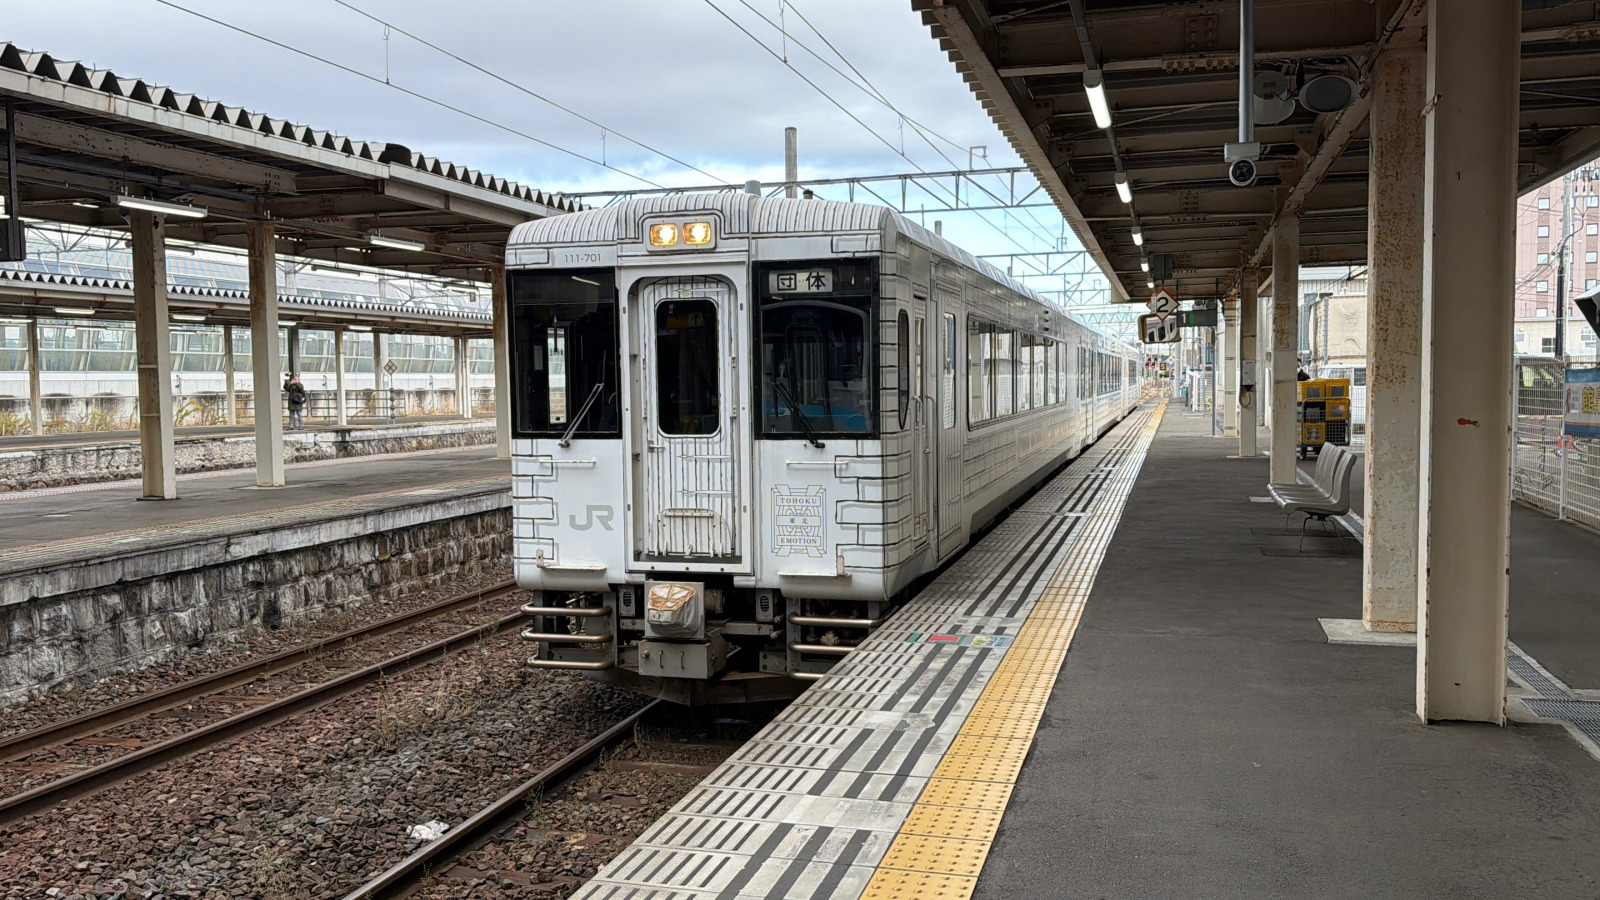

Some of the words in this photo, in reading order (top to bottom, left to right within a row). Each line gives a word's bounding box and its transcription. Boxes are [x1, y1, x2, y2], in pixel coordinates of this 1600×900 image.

[564, 253, 601, 263] 111-701
[777, 271, 826, 291] 団体
[1156, 296, 1169, 312] 2
[1181, 313, 1186, 324] 1
[569, 504, 614, 531] JR
